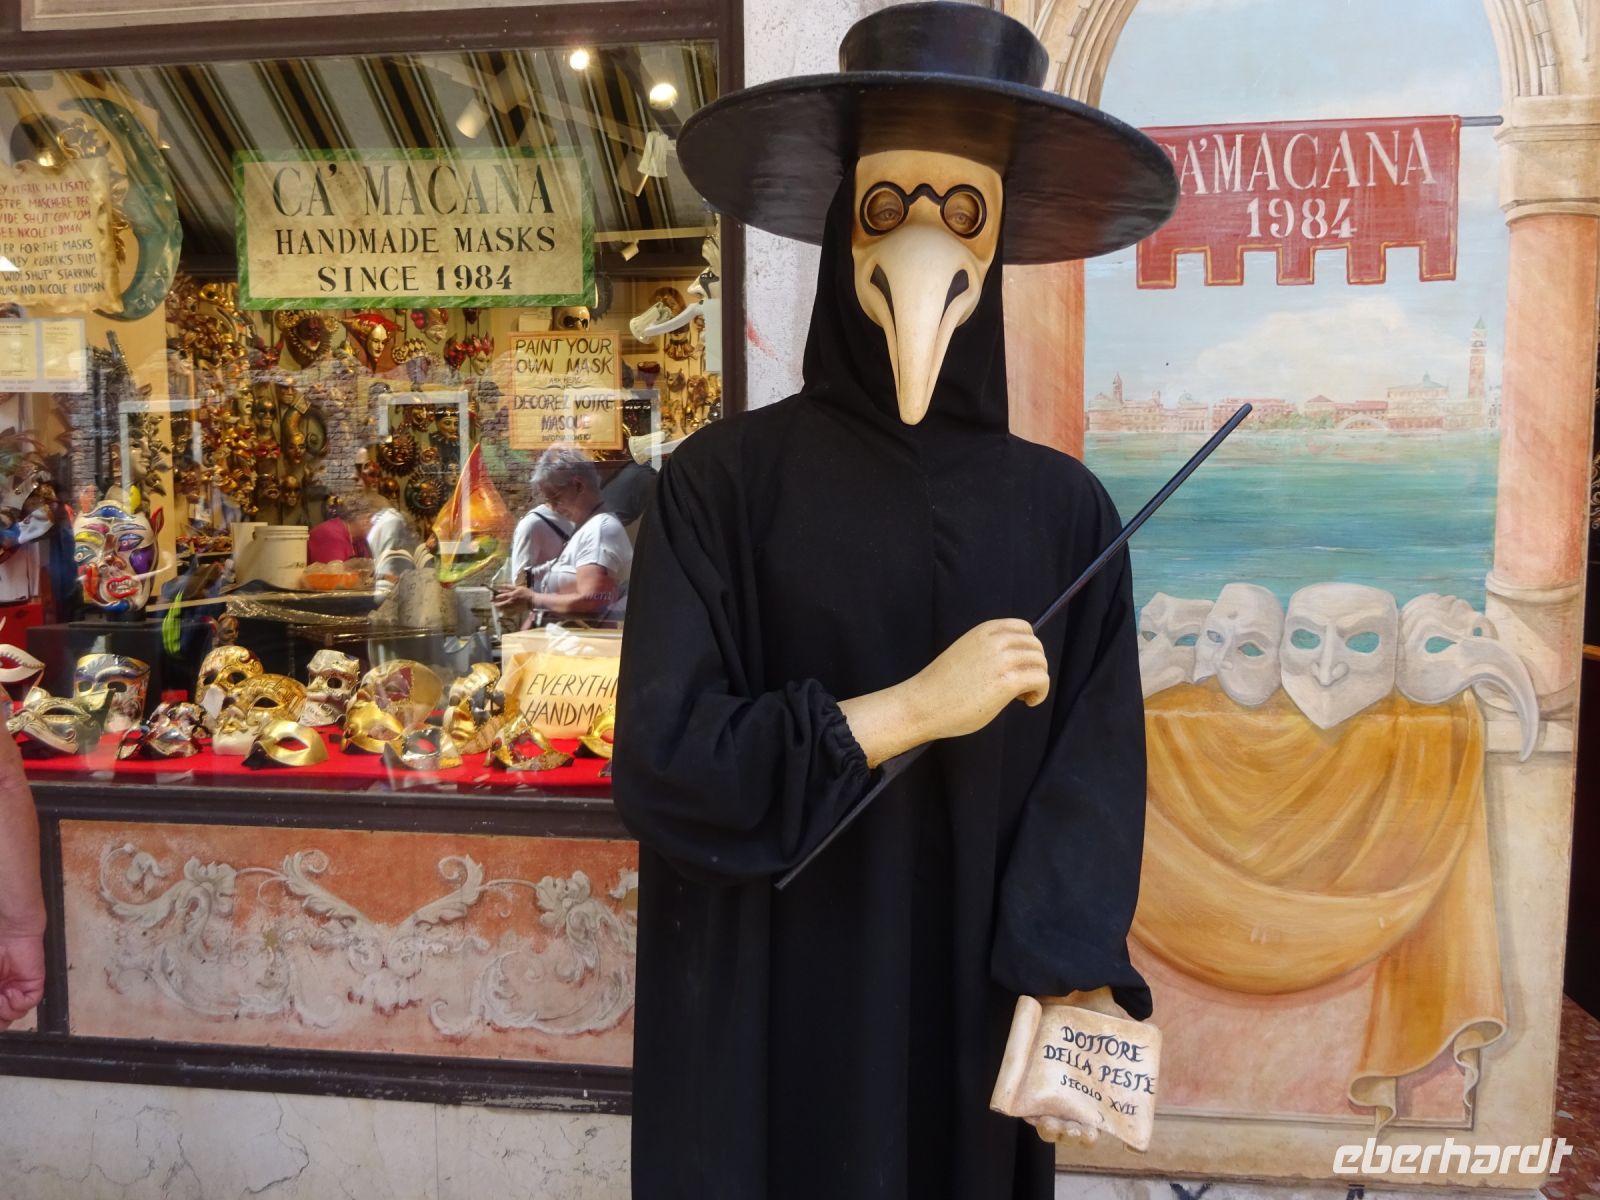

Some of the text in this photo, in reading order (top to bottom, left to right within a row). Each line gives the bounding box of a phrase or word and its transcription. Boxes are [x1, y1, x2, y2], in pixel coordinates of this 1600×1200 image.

[1157, 127, 1437, 196] A'MACANA
[272, 162, 555, 218] CA' MACANA
[1246, 197, 1358, 239] 1984
[275, 226, 556, 255] HANDMADE MASKS
[317, 264, 513, 292] SINCE 1984
[515, 337, 613, 356] PAINT YOUR
[516, 357, 614, 376] OWN MASK
[574, 393, 616, 412] VOTRE
[1060, 1025, 1149, 1063] DOTTORE
[1043, 1044, 1156, 1095] DELLA PESTE
[1107, 1095, 1139, 1116] XVII
